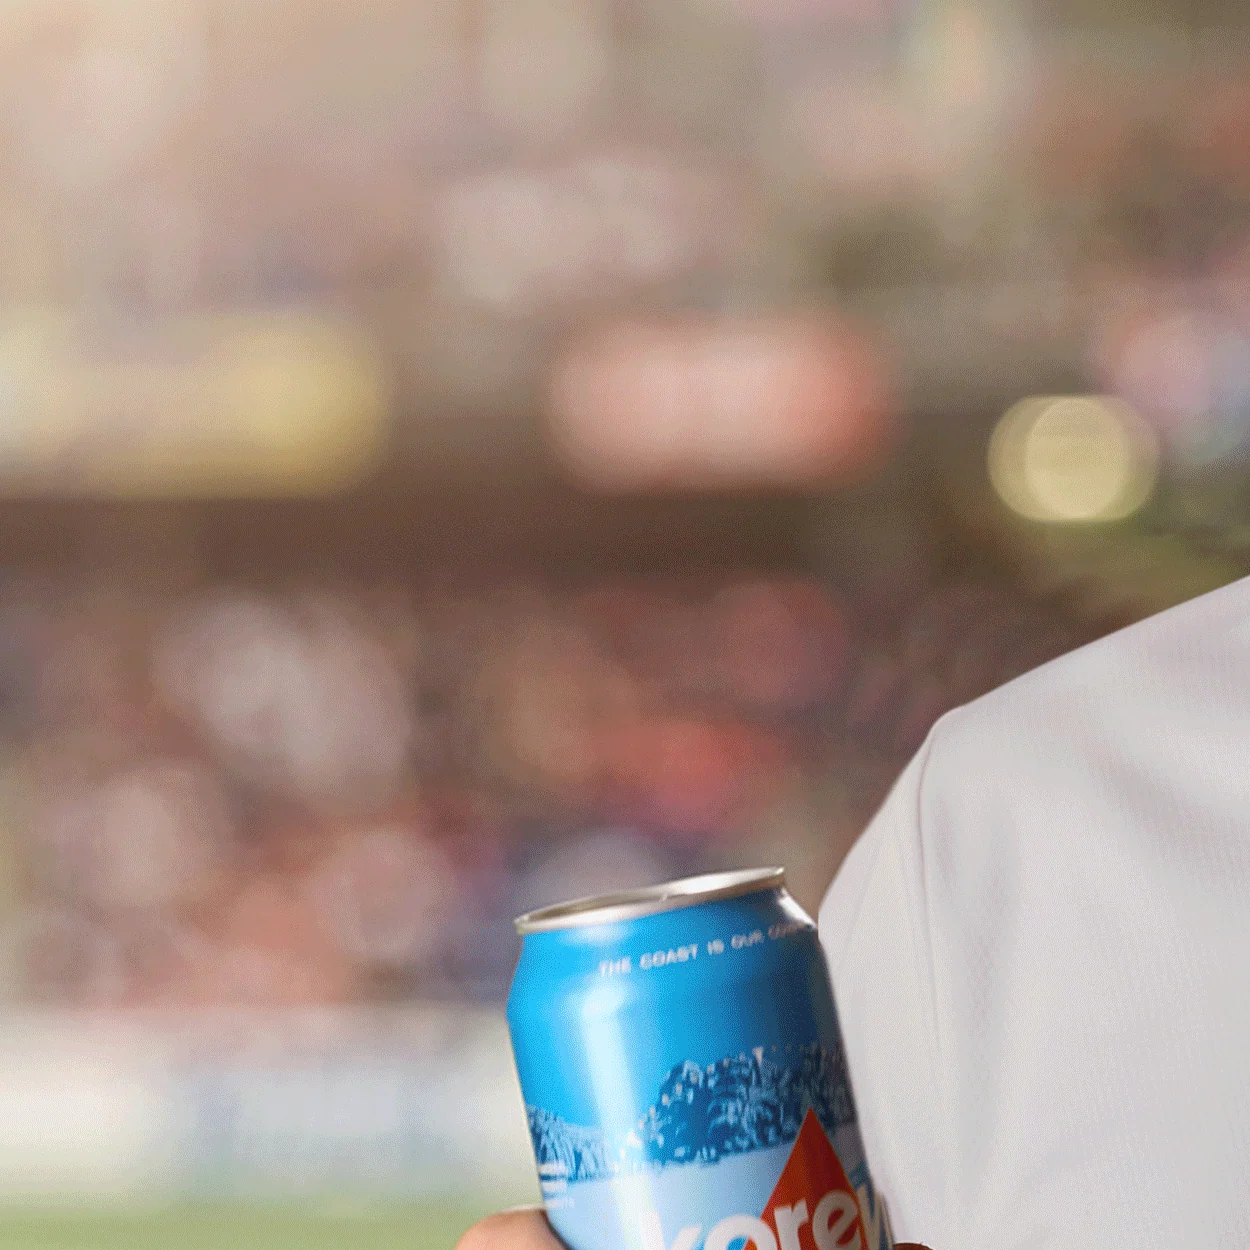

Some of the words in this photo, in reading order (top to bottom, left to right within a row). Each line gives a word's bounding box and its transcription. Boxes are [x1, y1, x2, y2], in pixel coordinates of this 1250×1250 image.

[600, 956, 631, 977] THE
[640, 944, 698, 971] COAST
[707, 938, 725, 956] IS
